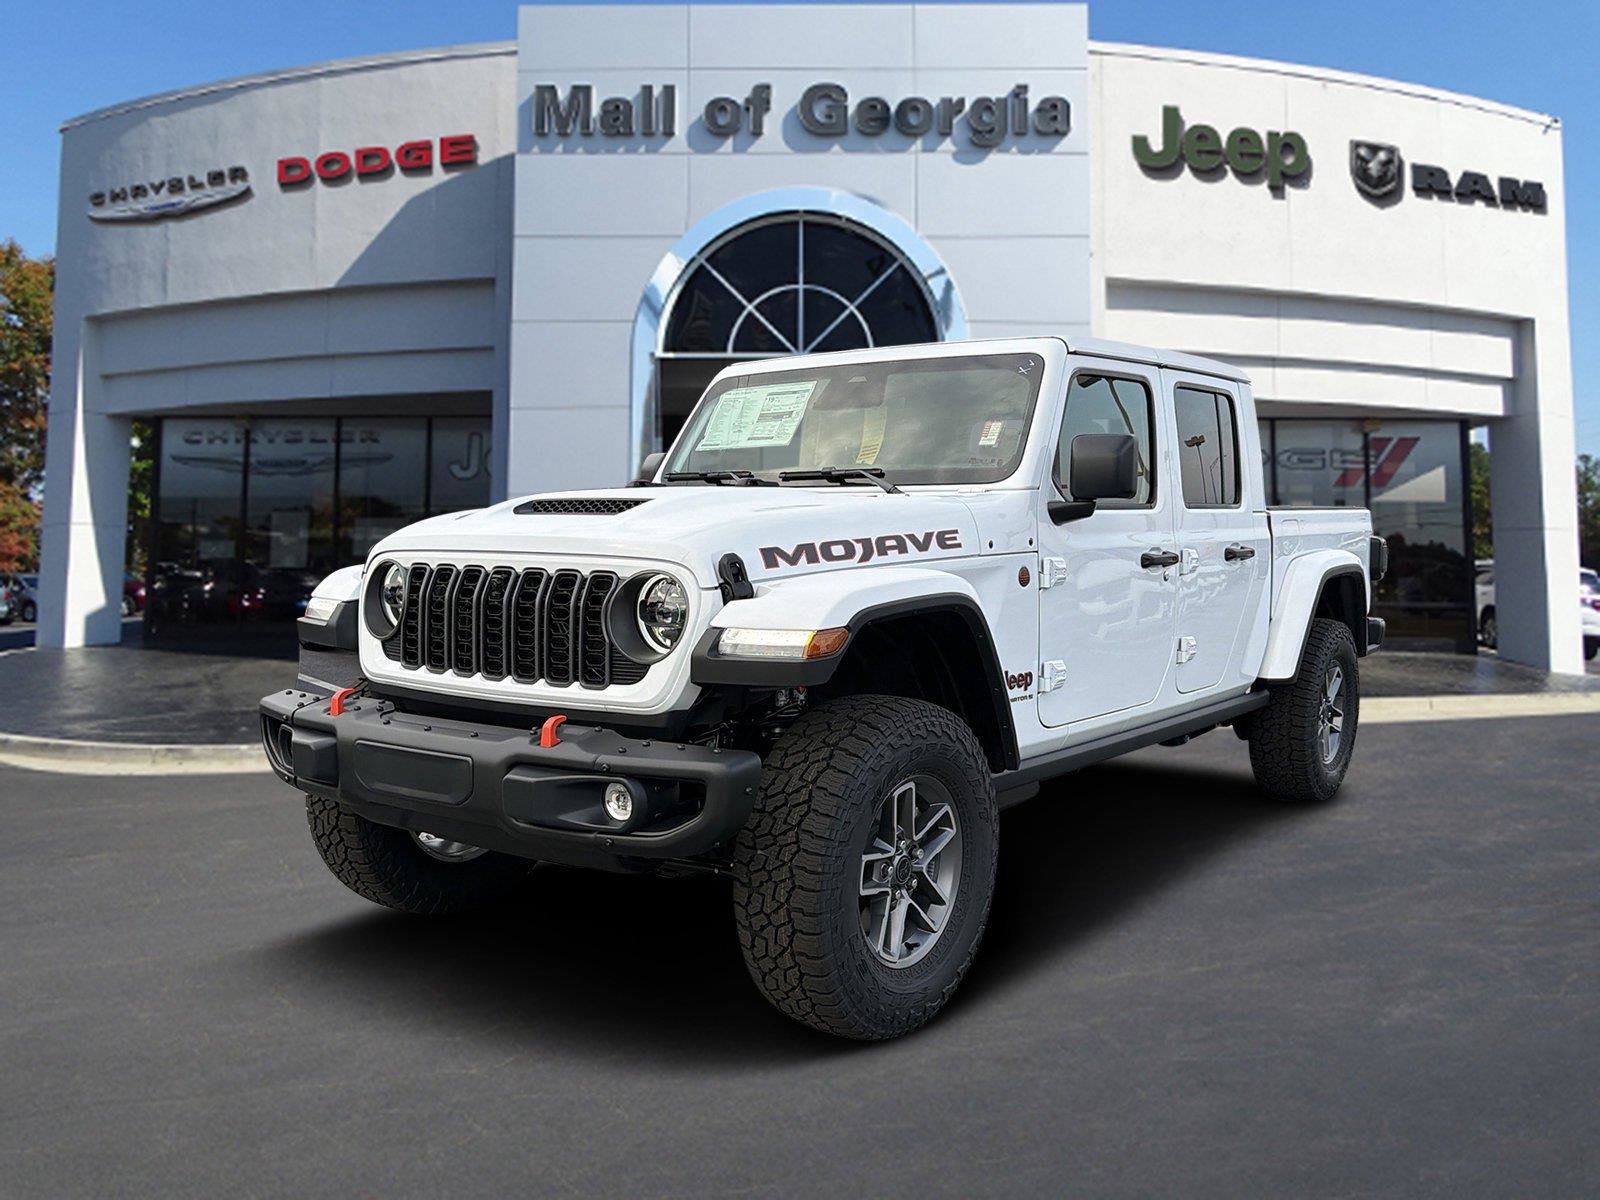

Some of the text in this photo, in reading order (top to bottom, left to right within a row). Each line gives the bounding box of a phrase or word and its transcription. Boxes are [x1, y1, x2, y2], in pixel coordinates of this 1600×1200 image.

[532, 82, 1072, 148] Mall of Georgia
[277, 134, 477, 187] DODGE
[1132, 105, 1310, 190] Jeep
[89, 166, 248, 207] CHRYSLER
[1411, 163, 1547, 213] RAM
[758, 528, 963, 570] MOJAVE
